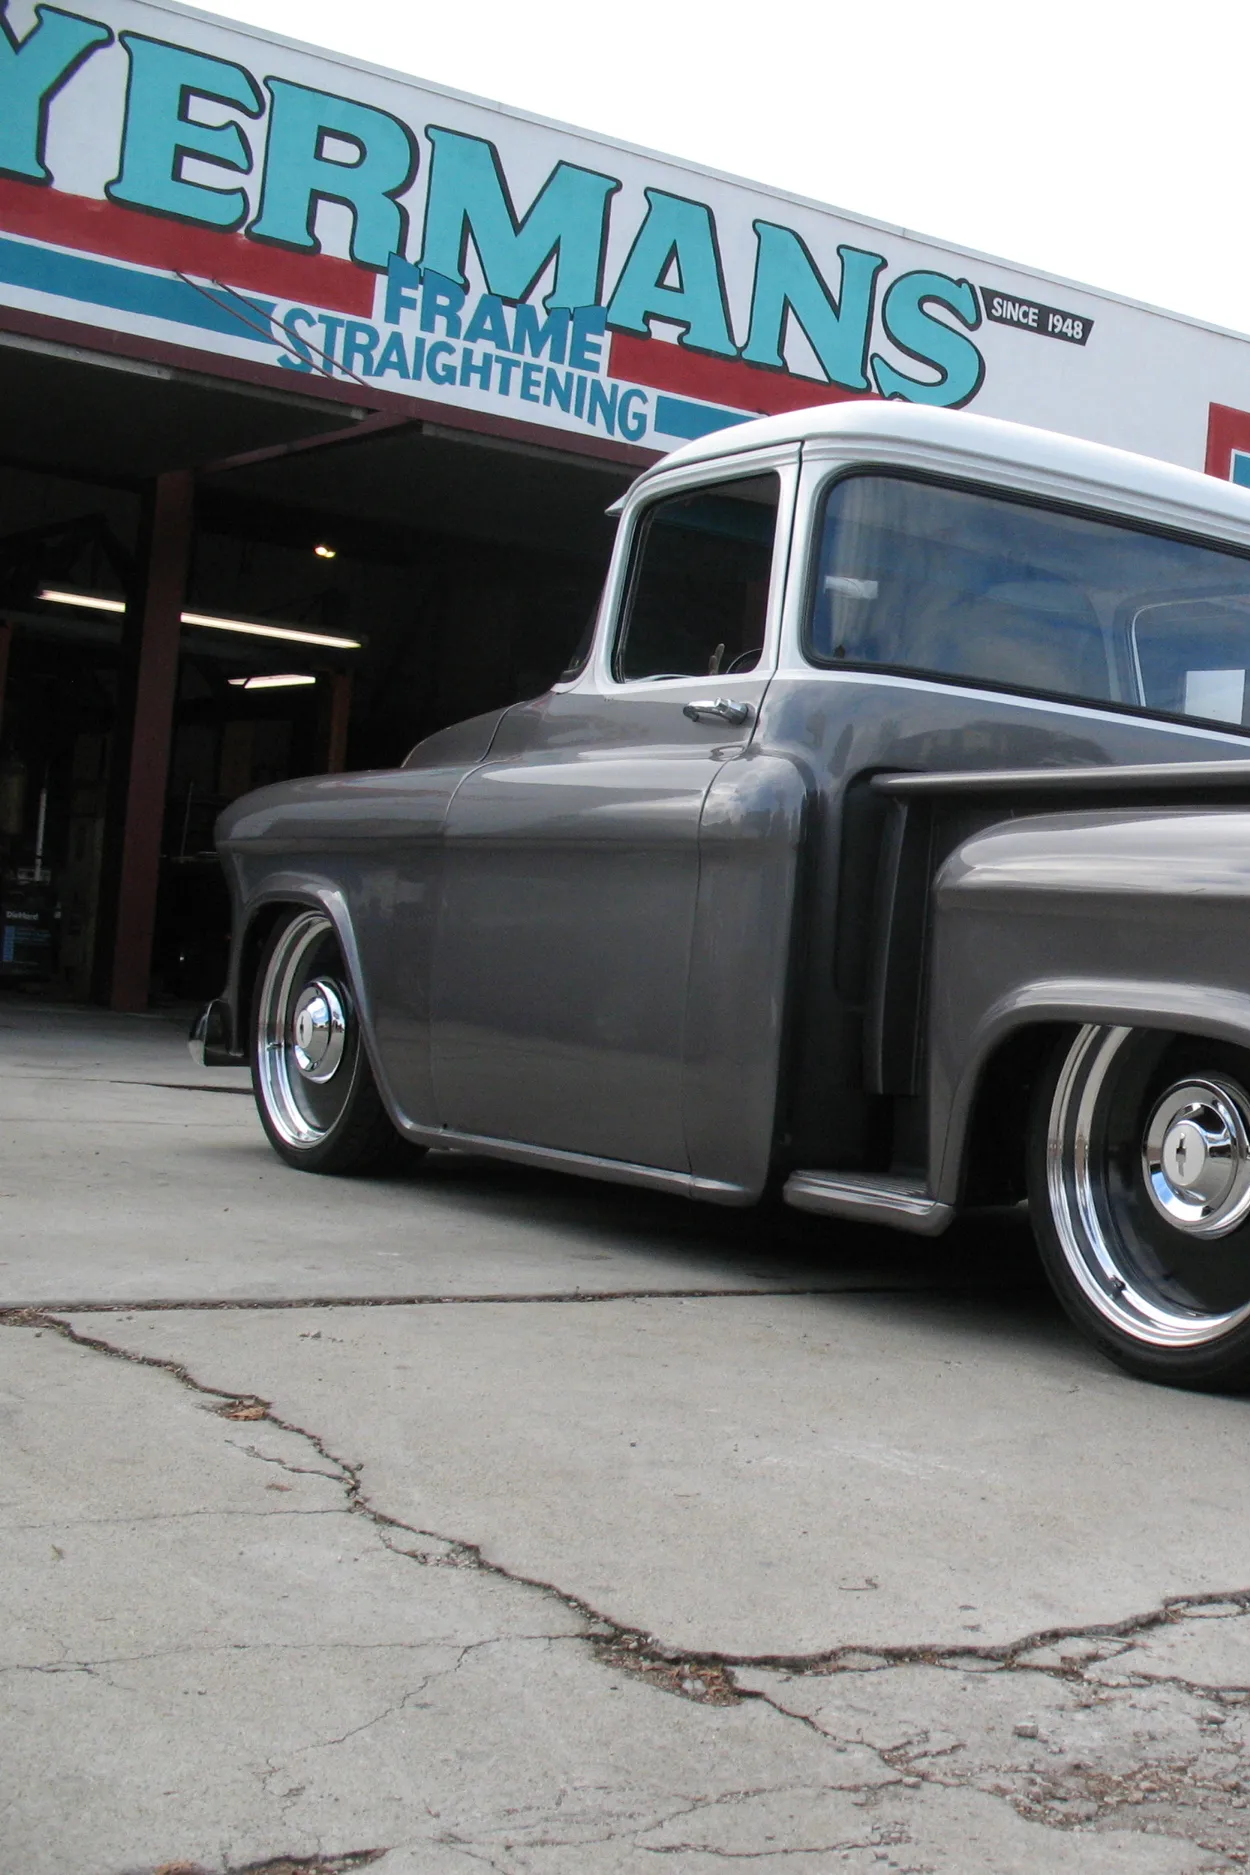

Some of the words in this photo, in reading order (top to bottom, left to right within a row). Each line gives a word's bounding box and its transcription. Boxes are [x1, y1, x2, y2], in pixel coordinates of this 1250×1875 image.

[385, 252, 607, 373] FRAME
[991, 297, 1039, 328] SINCE
[1047, 313, 1084, 340] 1948
[277, 307, 648, 442] STRAIGHTENING
